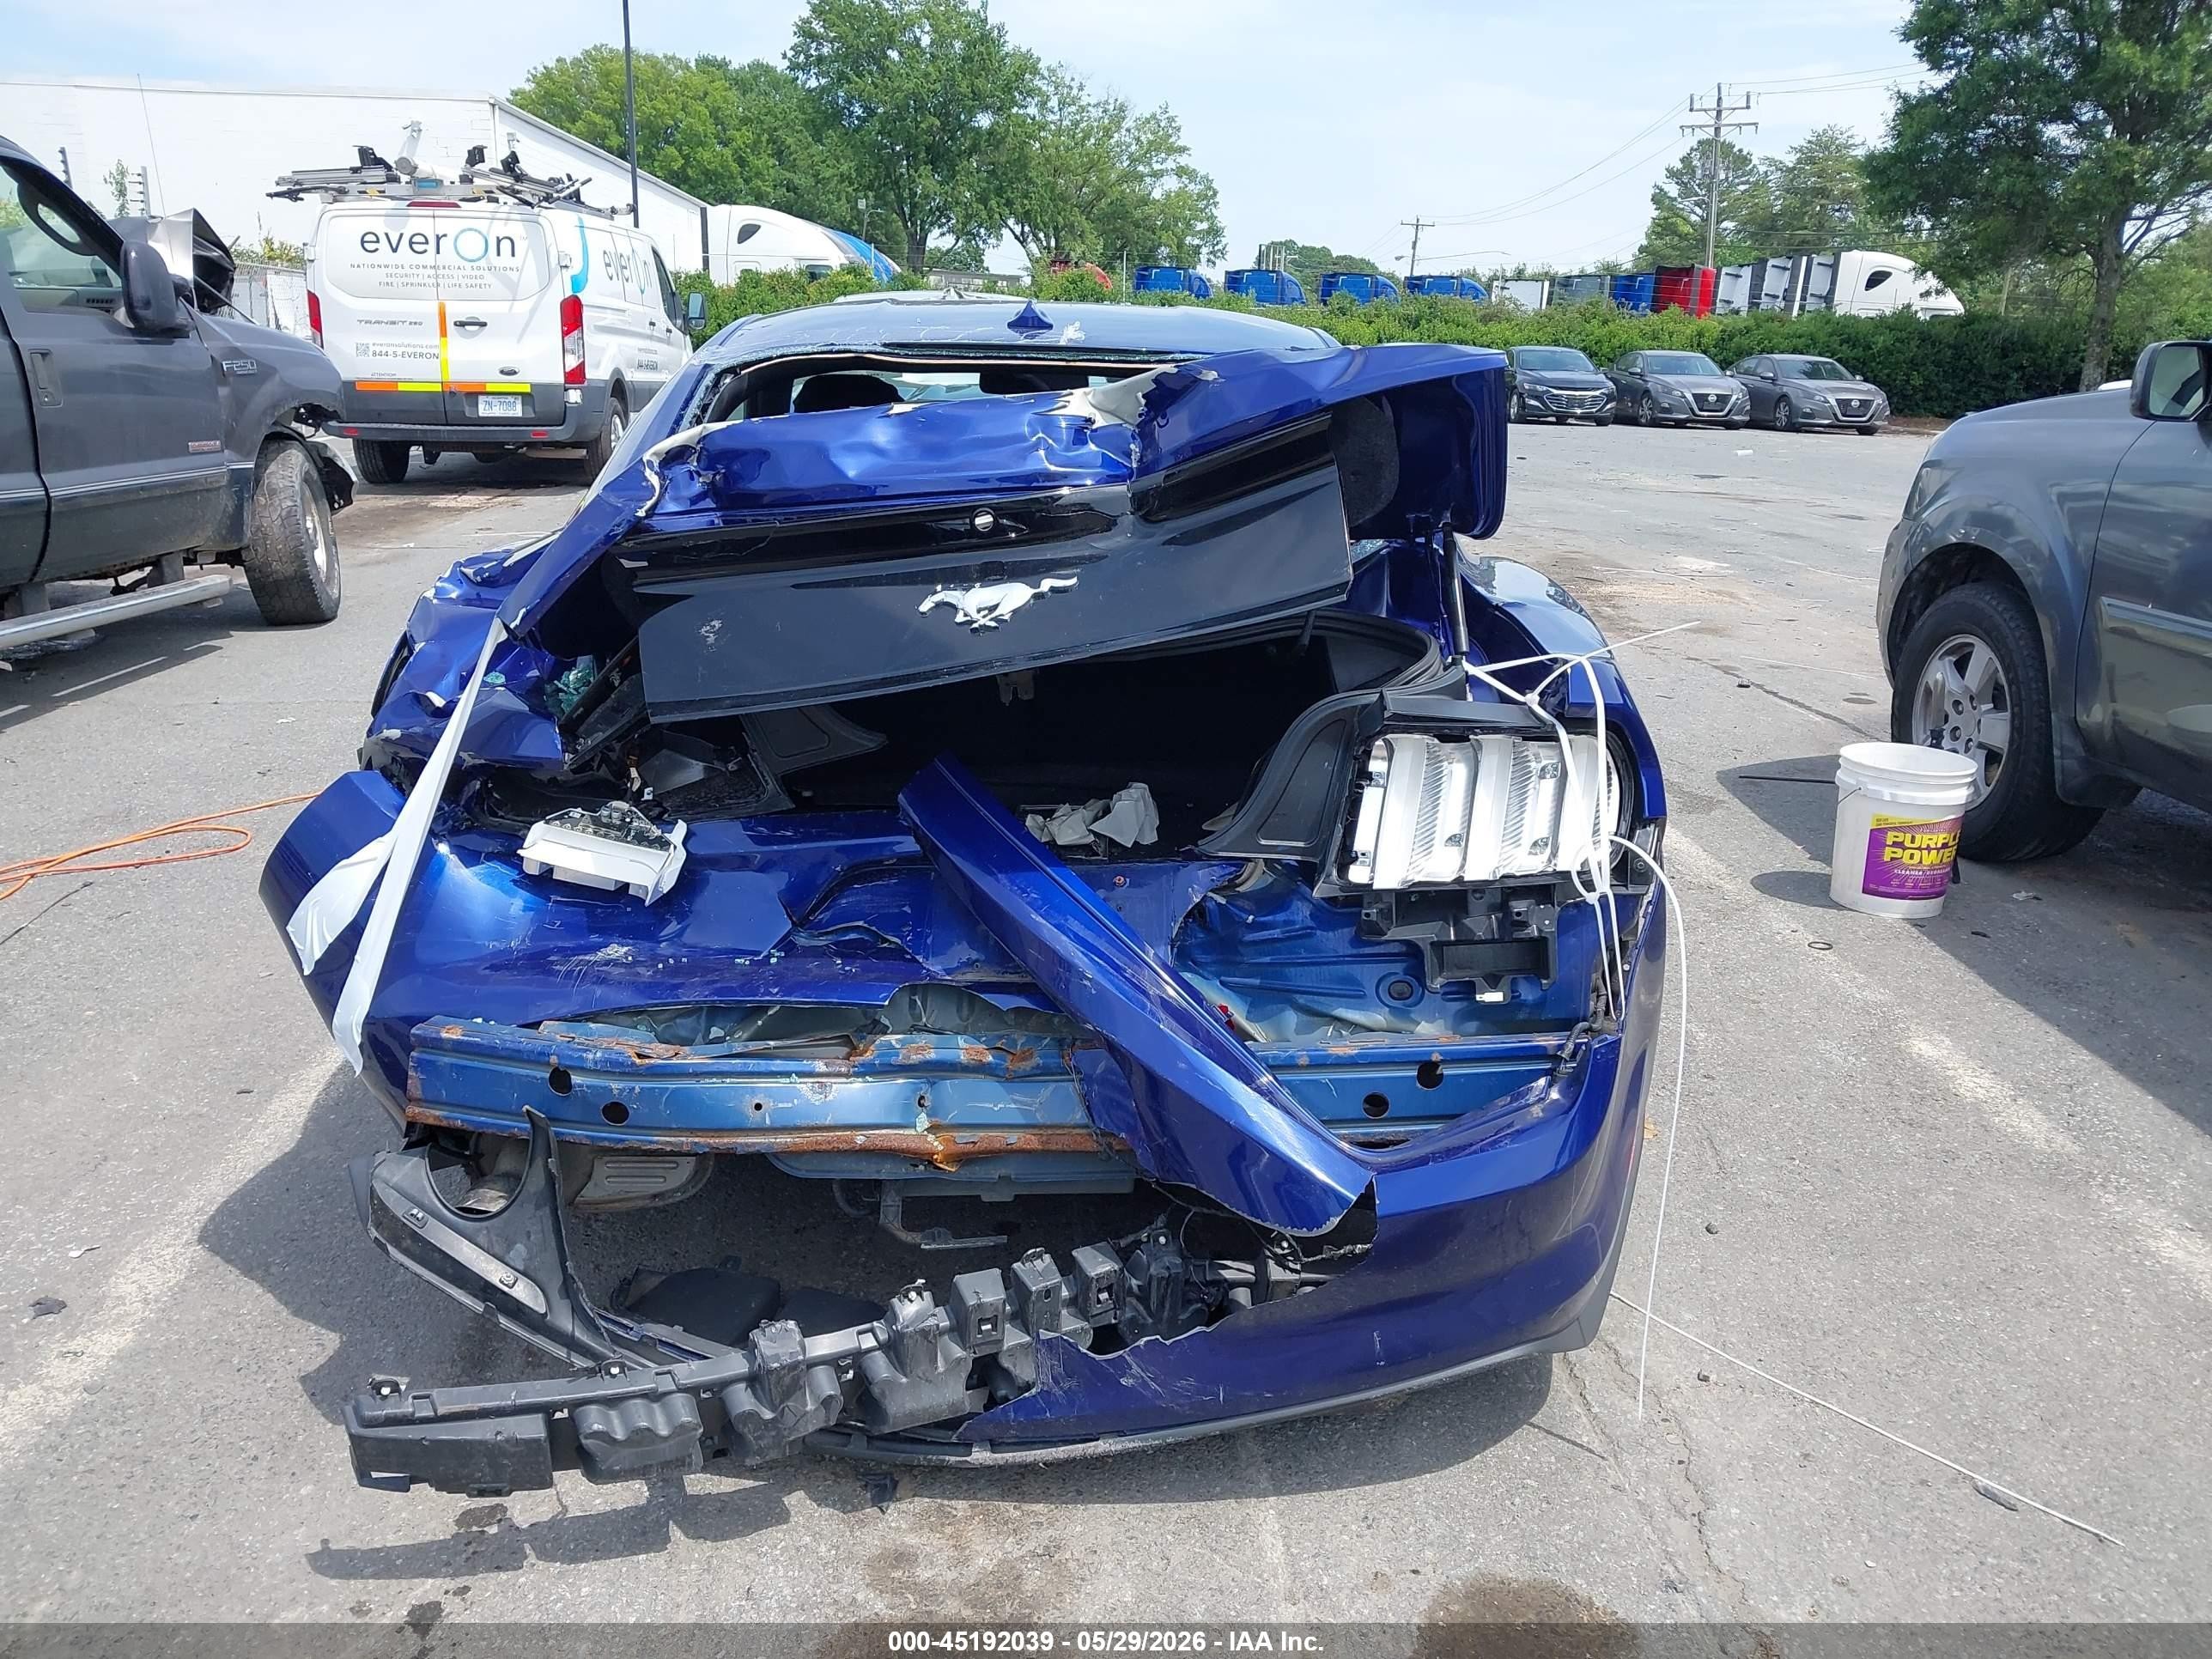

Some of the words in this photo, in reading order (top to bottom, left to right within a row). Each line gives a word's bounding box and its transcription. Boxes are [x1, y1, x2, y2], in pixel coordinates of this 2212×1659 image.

[372, 349, 440, 361] 844-5-EVERON
[222, 360, 257, 372] F250
[483, 399, 517, 412] ZN-7088
